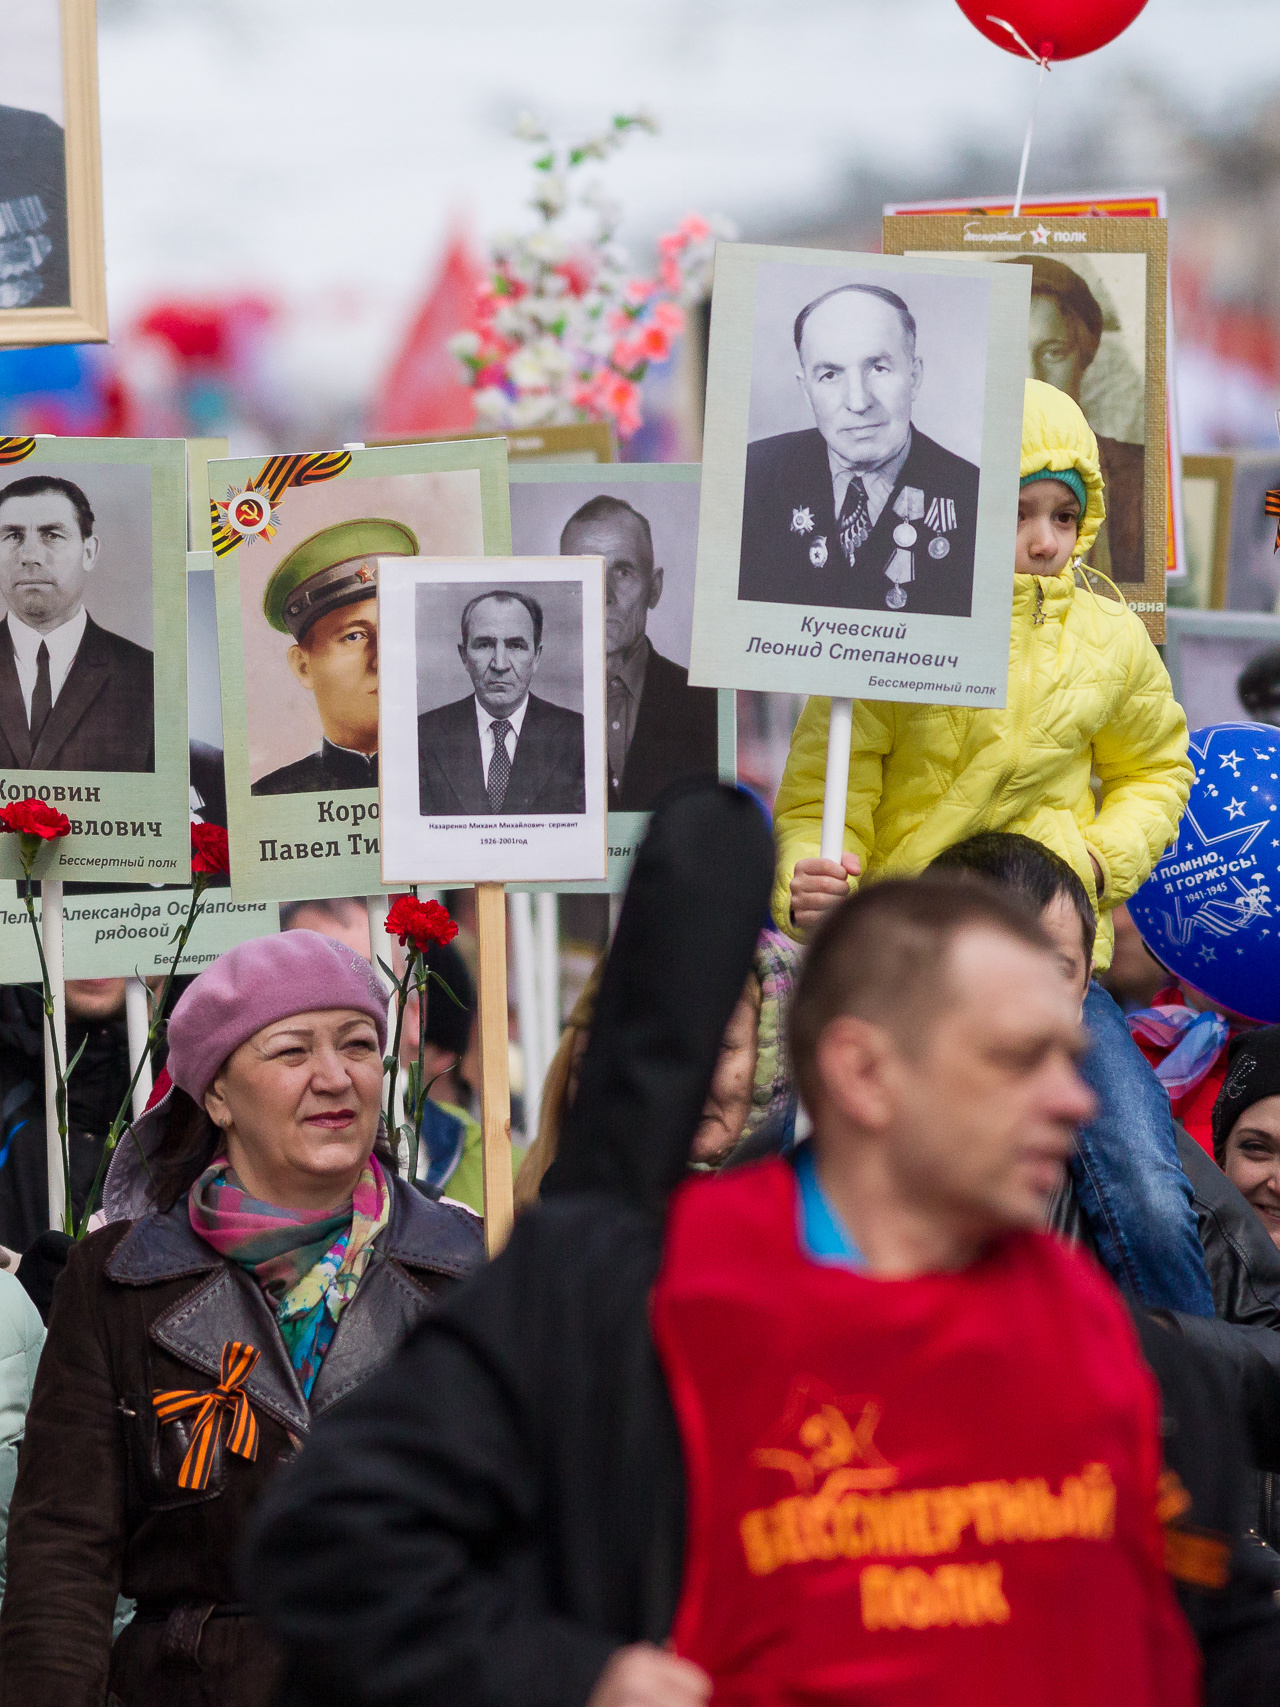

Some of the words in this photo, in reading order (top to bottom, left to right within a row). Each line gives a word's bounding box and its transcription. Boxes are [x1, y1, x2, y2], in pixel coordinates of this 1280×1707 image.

[800, 616, 907, 640] Кучевский
[745, 636, 822, 658] Леонид
[829, 642, 959, 668] Степанович
[868, 675, 962, 693] Бессмертный
[965, 684, 997, 695] полк
[317, 800, 380, 826] Коро
[70, 818, 163, 838] влович
[428, 822, 468, 831] Назаренко
[548, 821, 578, 830] сержант
[259, 838, 341, 862] Павел
[347, 833, 380, 855] Ти
[59, 854, 145, 869] Бессмертный
[147, 858, 177, 868] полк
[1160, 851, 1224, 879] ПОМНЮ,
[1164, 882, 1174, 894] Я
[1176, 854, 1257, 890] ГОРЖУСЬ!
[1185, 882, 1228, 903] 1941-1945
[62, 902, 161, 923] Александра
[94, 924, 169, 943] рядовой
[154, 952, 224, 965] Бессмерт
[859, 1559, 1011, 1632] ПОЛК
